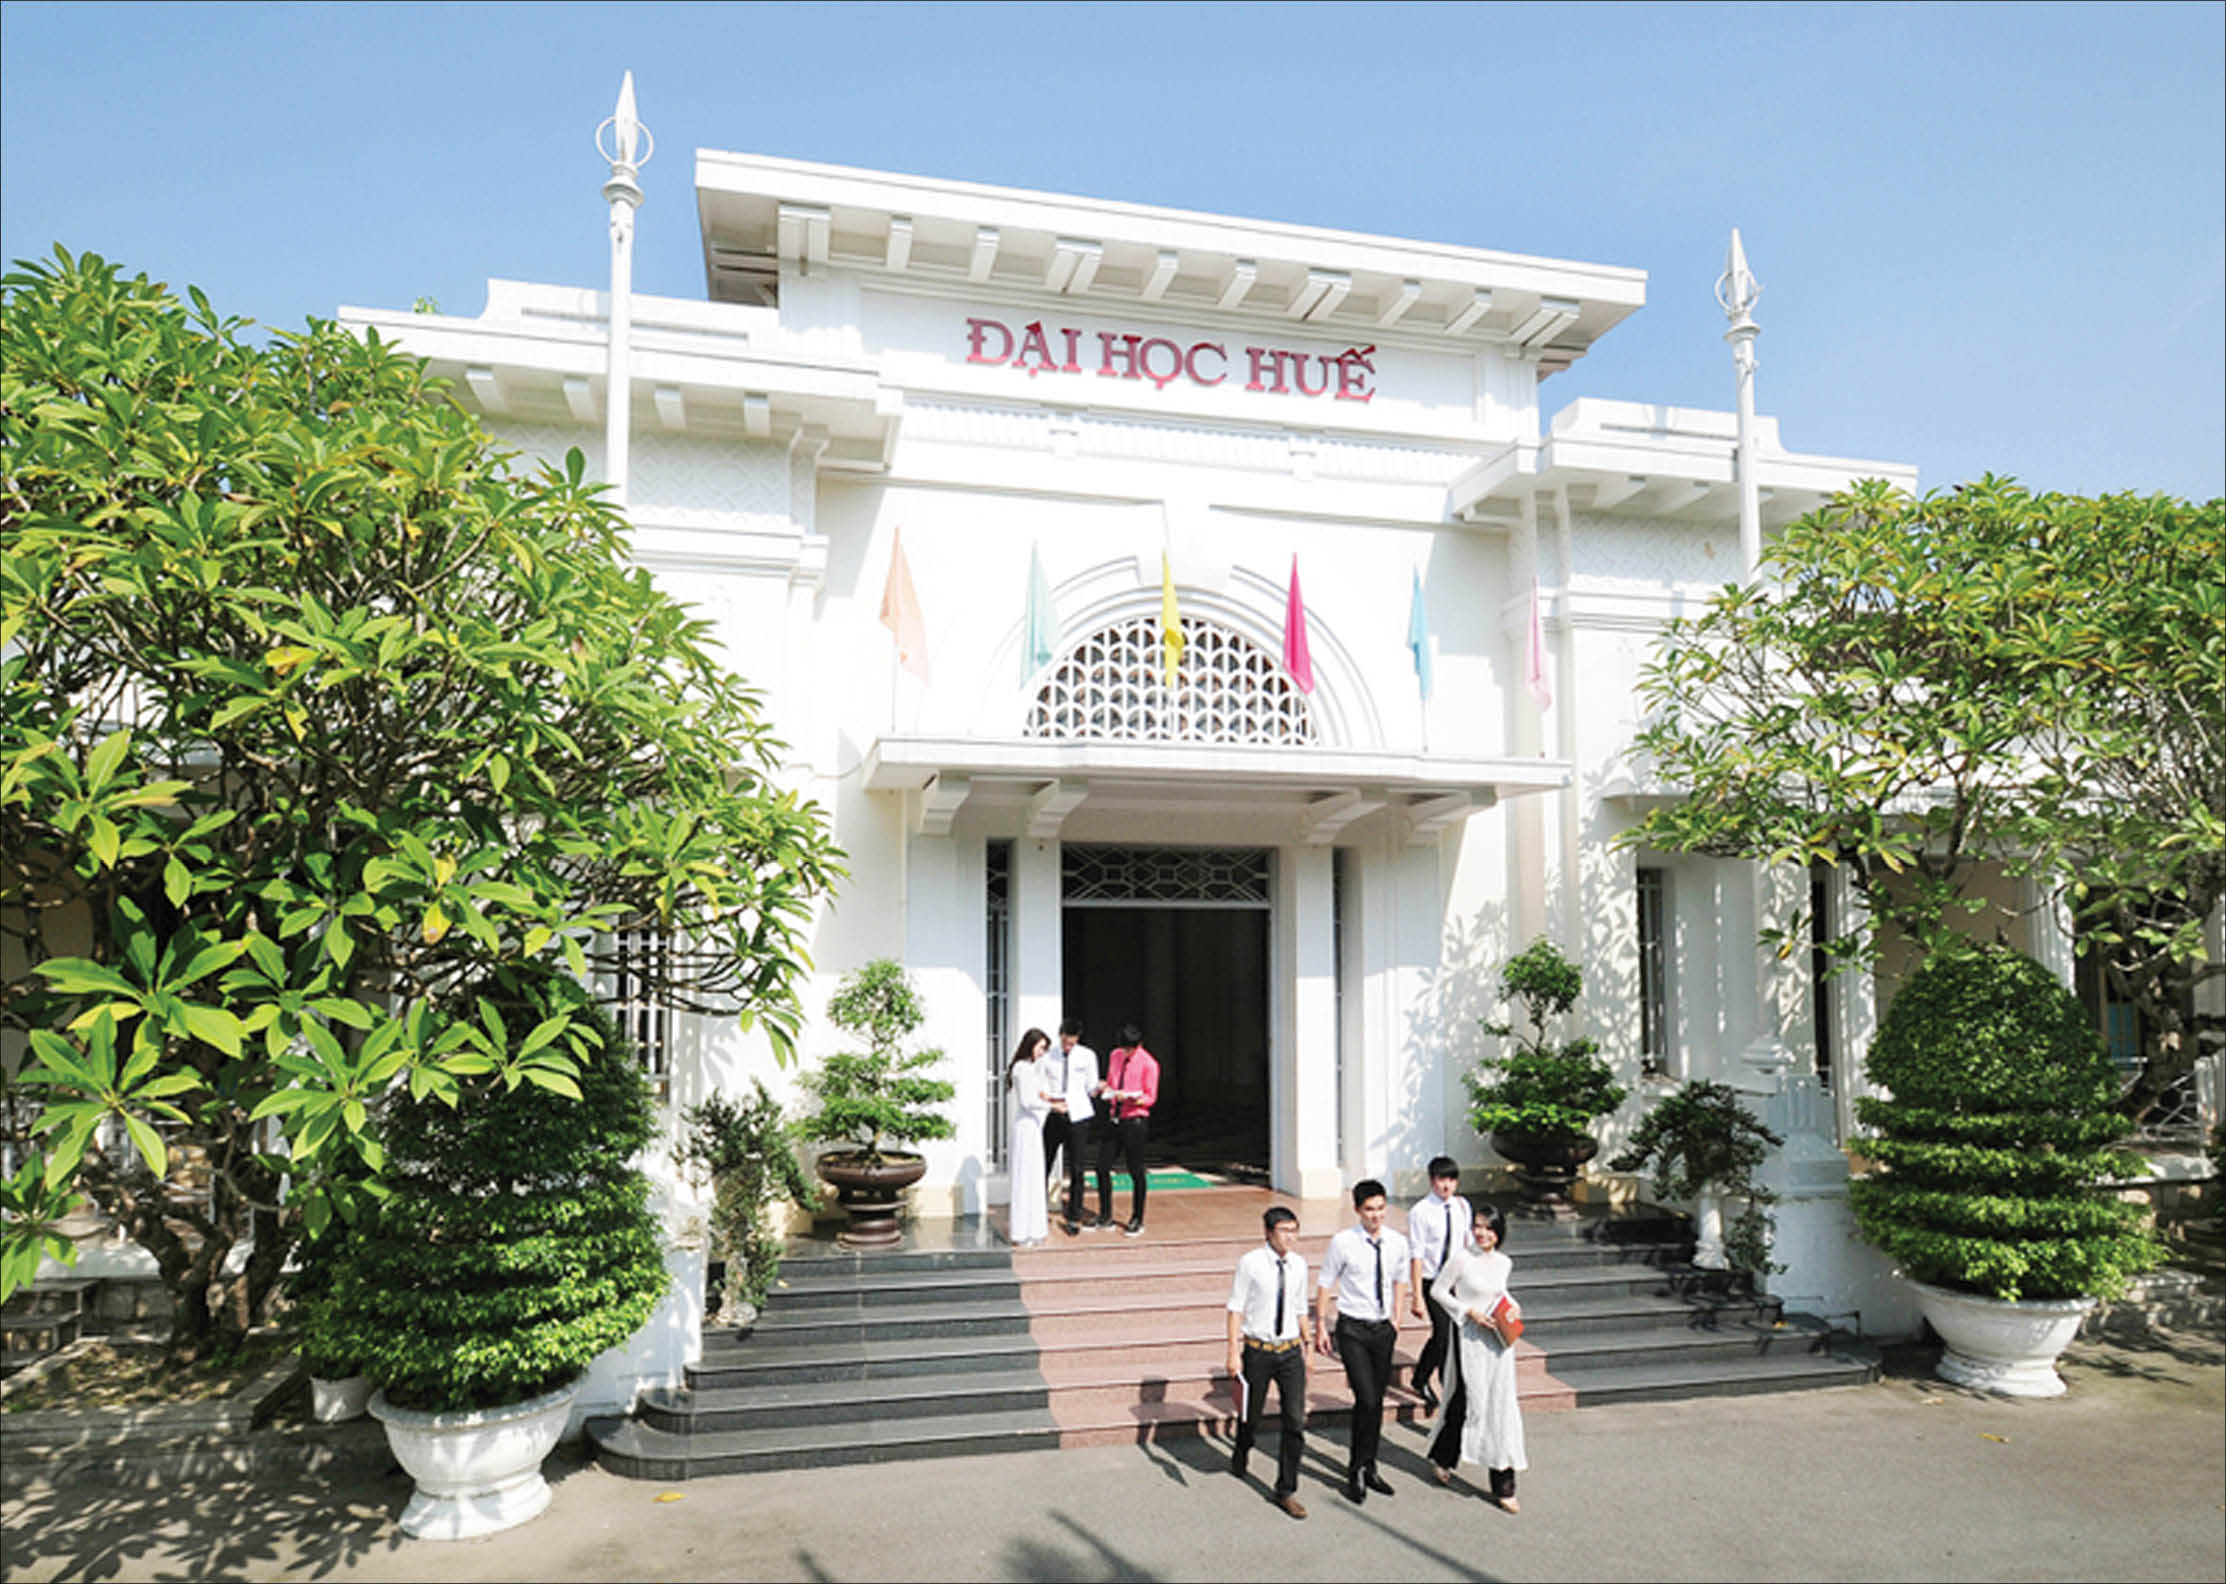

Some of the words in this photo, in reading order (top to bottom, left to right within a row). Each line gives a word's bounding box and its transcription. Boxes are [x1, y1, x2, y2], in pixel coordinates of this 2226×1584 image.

[966, 317, 1082, 377] ĐẠI
[1097, 331, 1228, 390] HỌC
[1245, 344, 1377, 403] HUẾ
